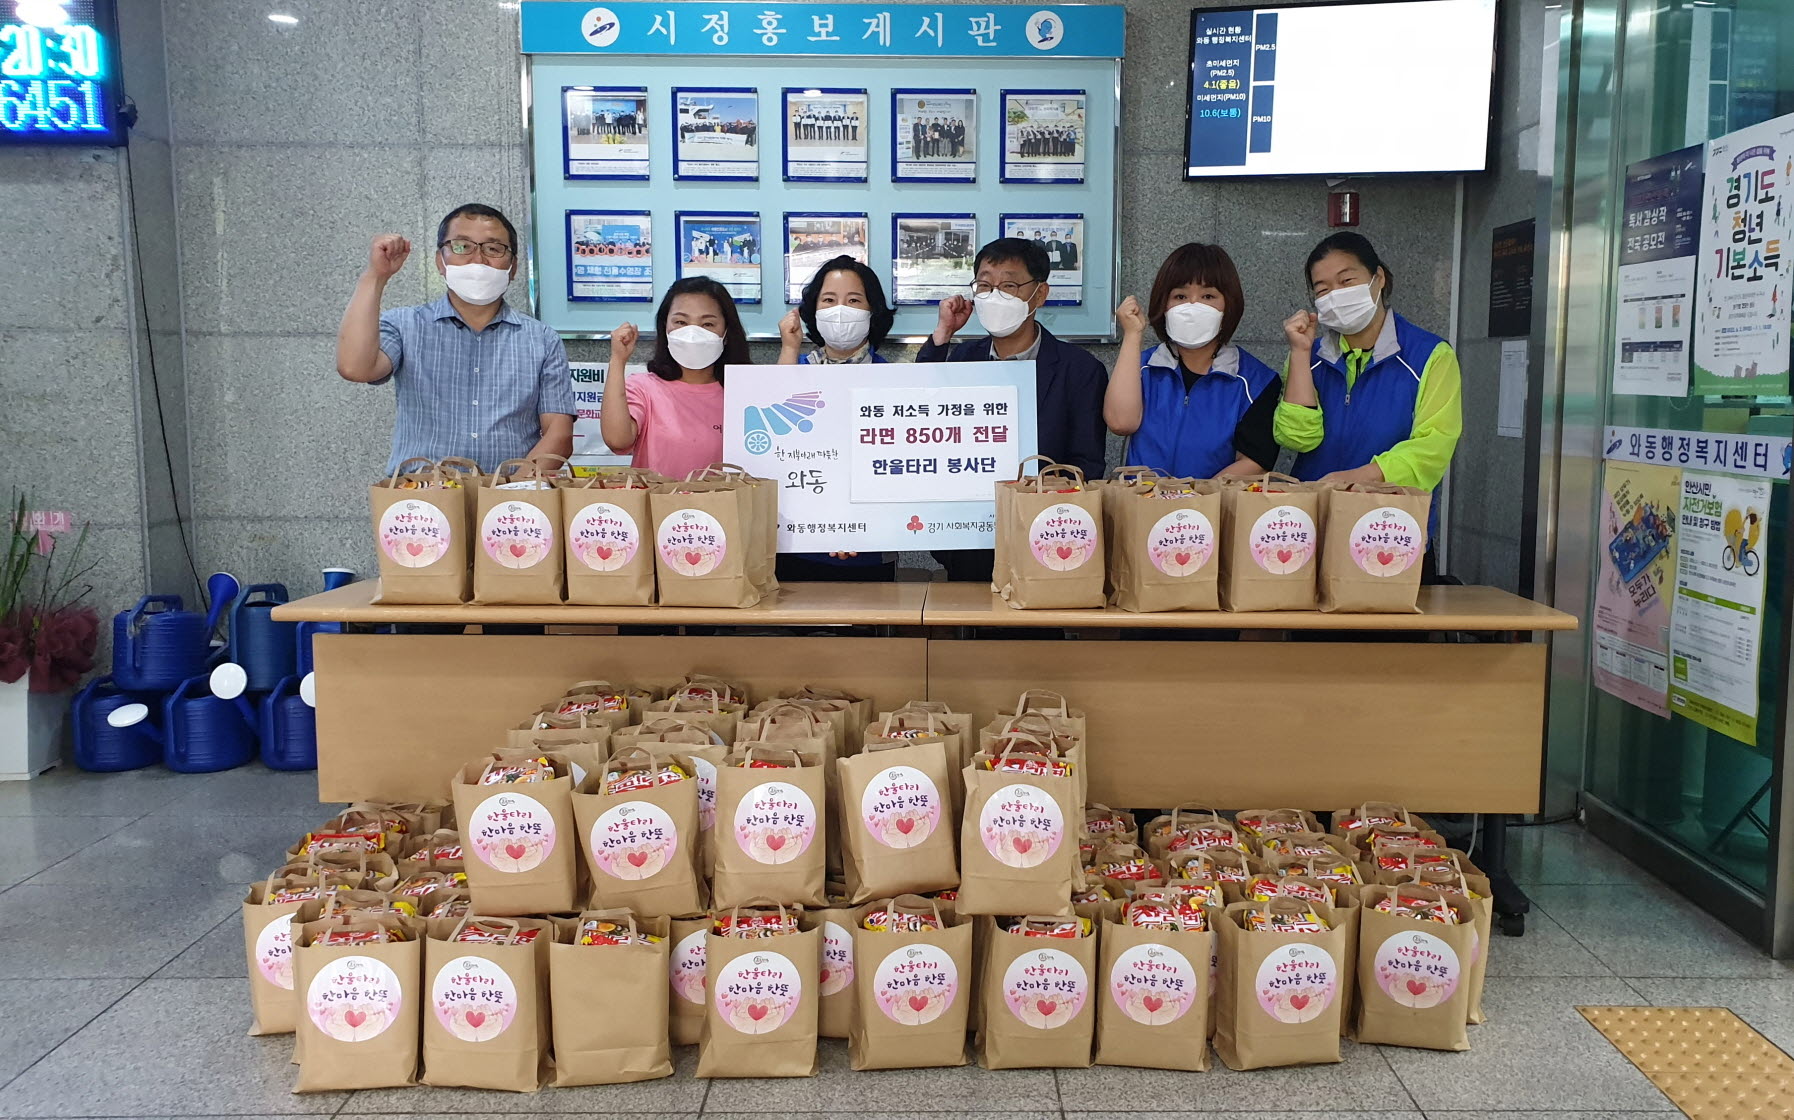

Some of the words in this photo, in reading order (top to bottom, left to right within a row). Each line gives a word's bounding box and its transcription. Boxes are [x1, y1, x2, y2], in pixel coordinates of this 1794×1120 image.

[647, 9, 1002, 49] 시정홍보게시판
[1206, 27, 1226, 35] 실시간
[1210, 69, 1235, 77] (PM2.5)
[1200, 108, 1241, 118] 10.6(보통)
[1726, 168, 1776, 209] 경기도
[1732, 209, 1764, 245] 청년
[1715, 239, 1781, 282] 기본소득
[859, 405, 885, 418] 와동
[892, 404, 930, 417] 저소득
[936, 403, 976, 417] 가정을
[982, 402, 1009, 416] 위한
[859, 427, 896, 446] 라면
[905, 426, 963, 445] 850개
[972, 425, 1009, 443] 전달
[1629, 433, 1769, 472] 와동행정복지센터
[872, 458, 938, 476] 한울타리
[946, 456, 997, 474] 봉사단
[784, 469, 828, 495] 와동
[786, 521, 867, 534] 와동행정복지센터
[927, 522, 944, 534] 경기
[946, 520, 996, 533] 사회복지공동
[878, 783, 919, 796] 한울타리
[754, 798, 798, 810] 한울타리
[874, 796, 904, 813] 한마음
[909, 795, 929, 808] 한뜻
[1001, 801, 1044, 813] 한울타리
[487, 809, 532, 821] 한울타리
[746, 812, 779, 826] 한마음
[784, 813, 805, 827] 한뜻
[482, 823, 515, 837] 한마음
[520, 823, 542, 836] 한뜻
[608, 818, 653, 832] 한울타리
[993, 815, 1026, 827] 한마음
[1030, 818, 1052, 832] 한뜻
[603, 831, 637, 848] 한마음
[641, 828, 663, 840] 한뜻
[1398, 946, 1442, 962] 한울타리
[738, 968, 782, 979] 한울타리
[894, 960, 937, 973] 한울타리
[1024, 964, 1068, 977] 한울타리
[1133, 960, 1177, 974] 한울타리
[1276, 960, 1319, 972] 한울타리
[1388, 959, 1422, 970] 한마음
[1427, 963, 1448, 978] 한뜻
[451, 973, 494, 986] 한울타리
[887, 974, 920, 990] 한마음
[925, 973, 946, 986] 한뜻
[1016, 978, 1050, 990] 한마음
[1055, 980, 1076, 993] 한뜻
[1124, 974, 1158, 987] 한마음
[1162, 977, 1184, 991] 한뜻
[1269, 973, 1302, 988] 한마음
[1307, 972, 1326, 984] 한뜻
[445, 988, 477, 1001] 한마음
[482, 991, 504, 1003] 한뜻
[728, 982, 763, 995] 한마음
[767, 983, 789, 997] 한뜻
